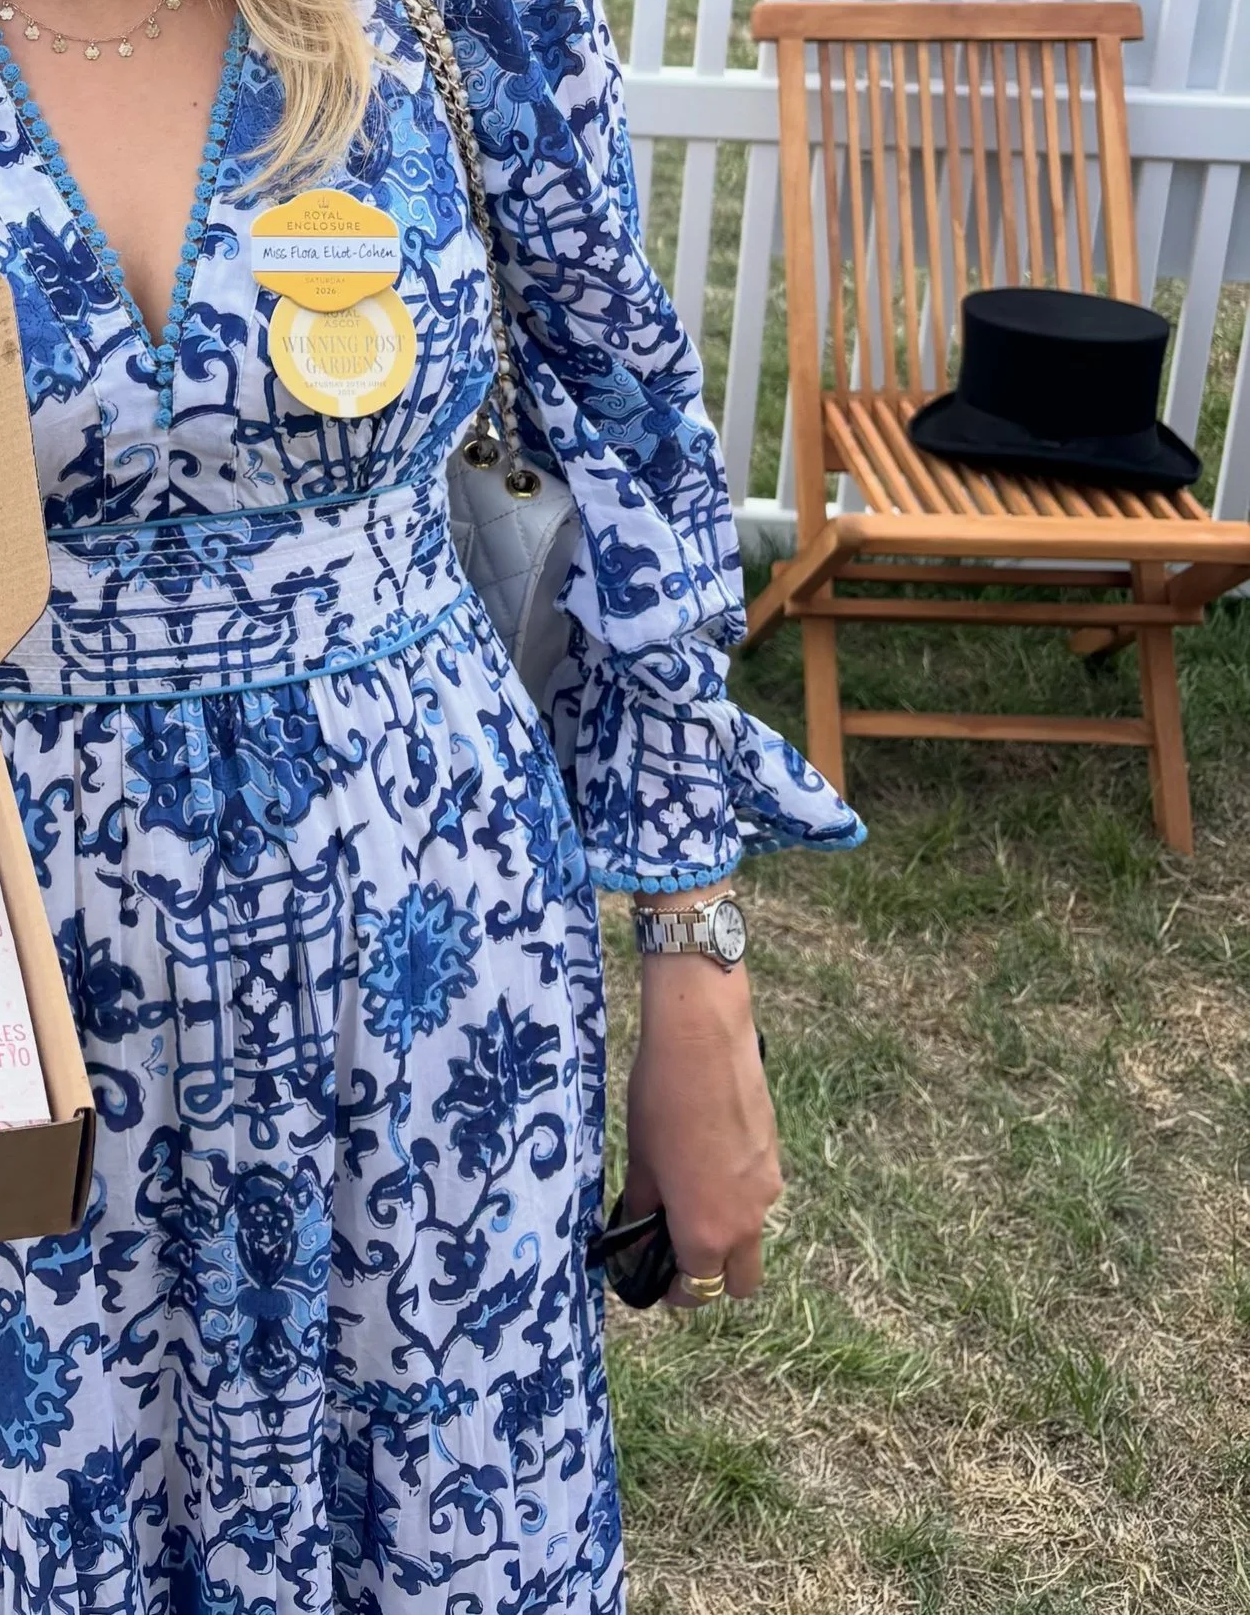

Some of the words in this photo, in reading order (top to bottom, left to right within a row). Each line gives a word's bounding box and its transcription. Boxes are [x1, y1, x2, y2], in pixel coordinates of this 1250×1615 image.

[304, 210, 343, 221] ROYAL
[287, 222, 361, 231] ENCLOSURE
[262, 245, 287, 259] Miss
[290, 245, 320, 259] Flora
[323, 243, 397, 259] Eliot-Cohen
[315, 287, 337, 295] 2026
[323, 319, 361, 328] ASCOT
[282, 335, 358, 354] WINNING
[365, 334, 405, 354] POST
[305, 355, 384, 375] GARDENS
